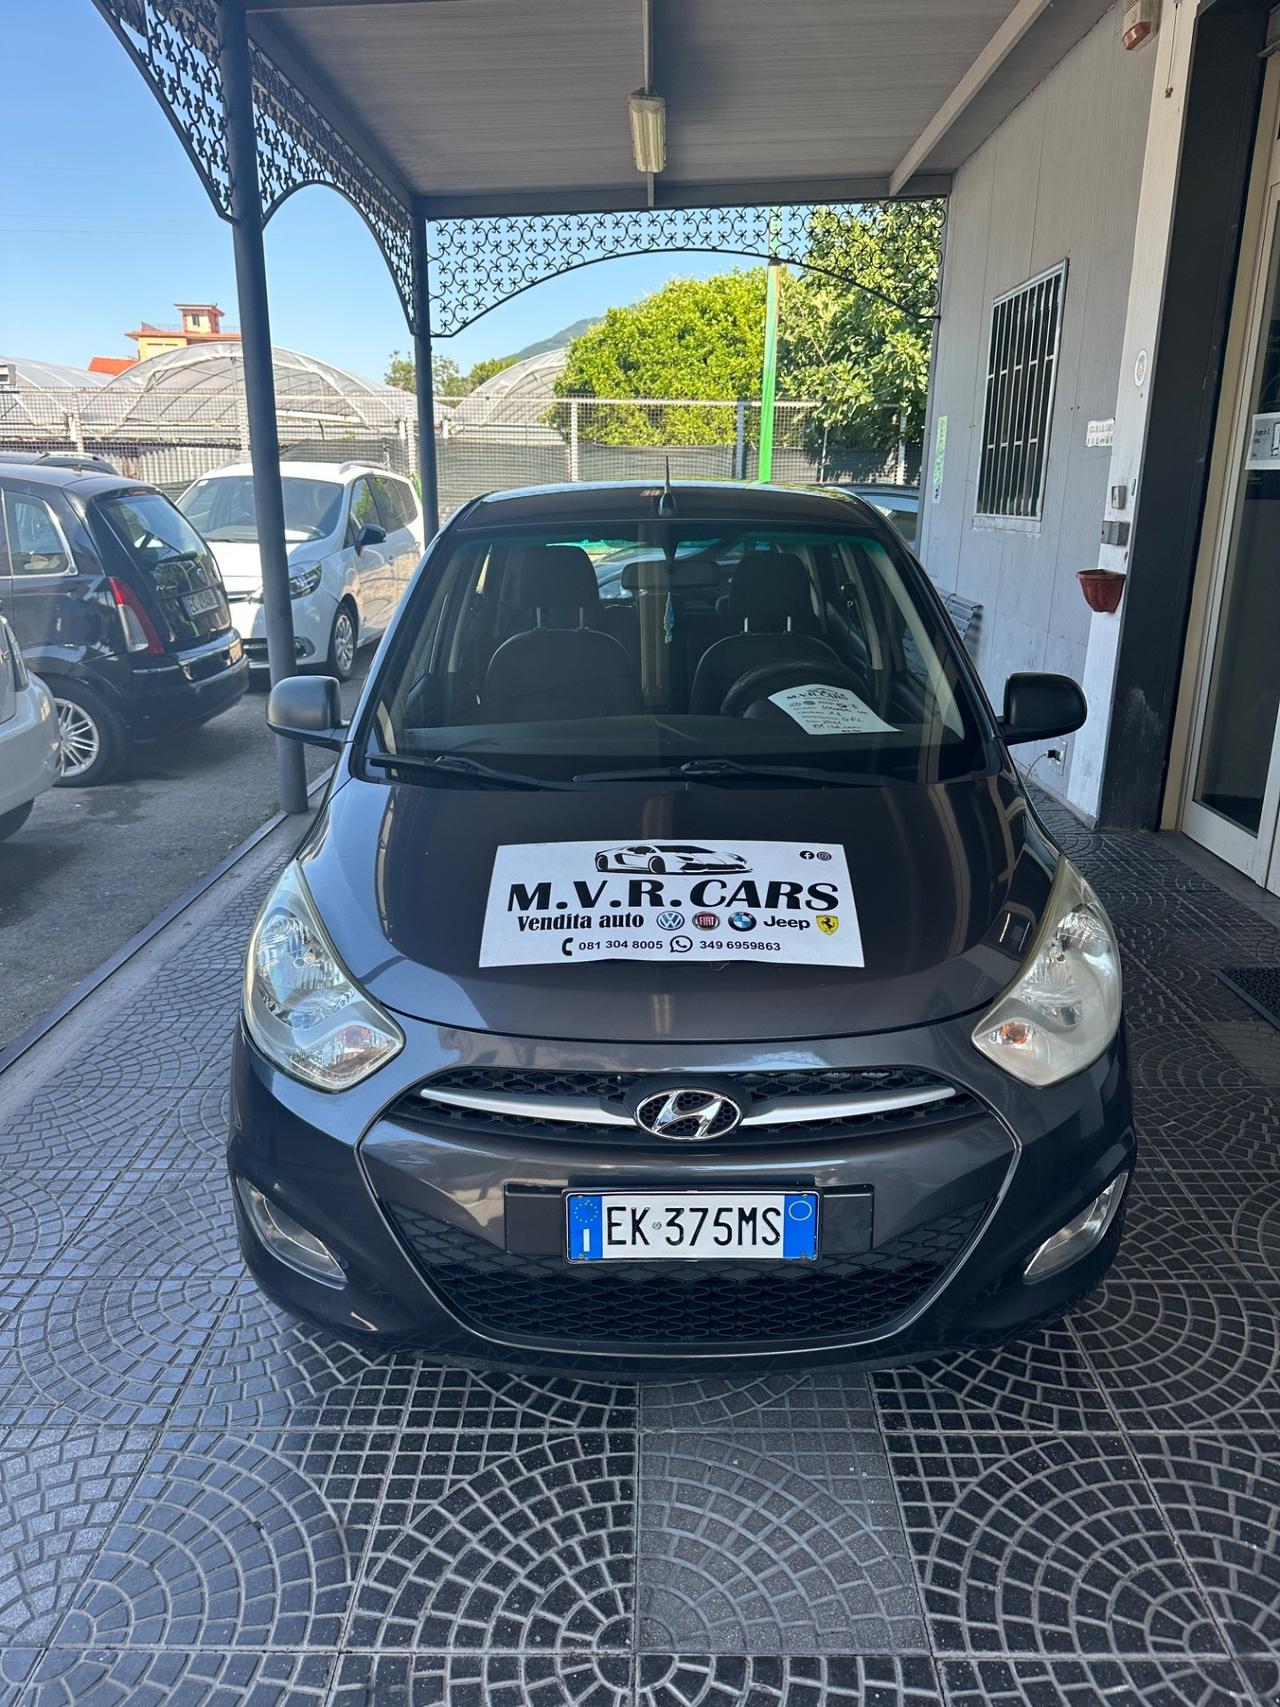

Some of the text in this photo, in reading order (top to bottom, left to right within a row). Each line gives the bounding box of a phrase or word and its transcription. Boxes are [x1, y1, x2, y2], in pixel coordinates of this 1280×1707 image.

[517, 912, 644, 932] Vendita auto
[699, 916, 715, 927] FIAT
[763, 915, 811, 931] Jeep
[578, 940, 663, 950] 081 304 8005
[699, 940, 781, 951] 349 6959863
